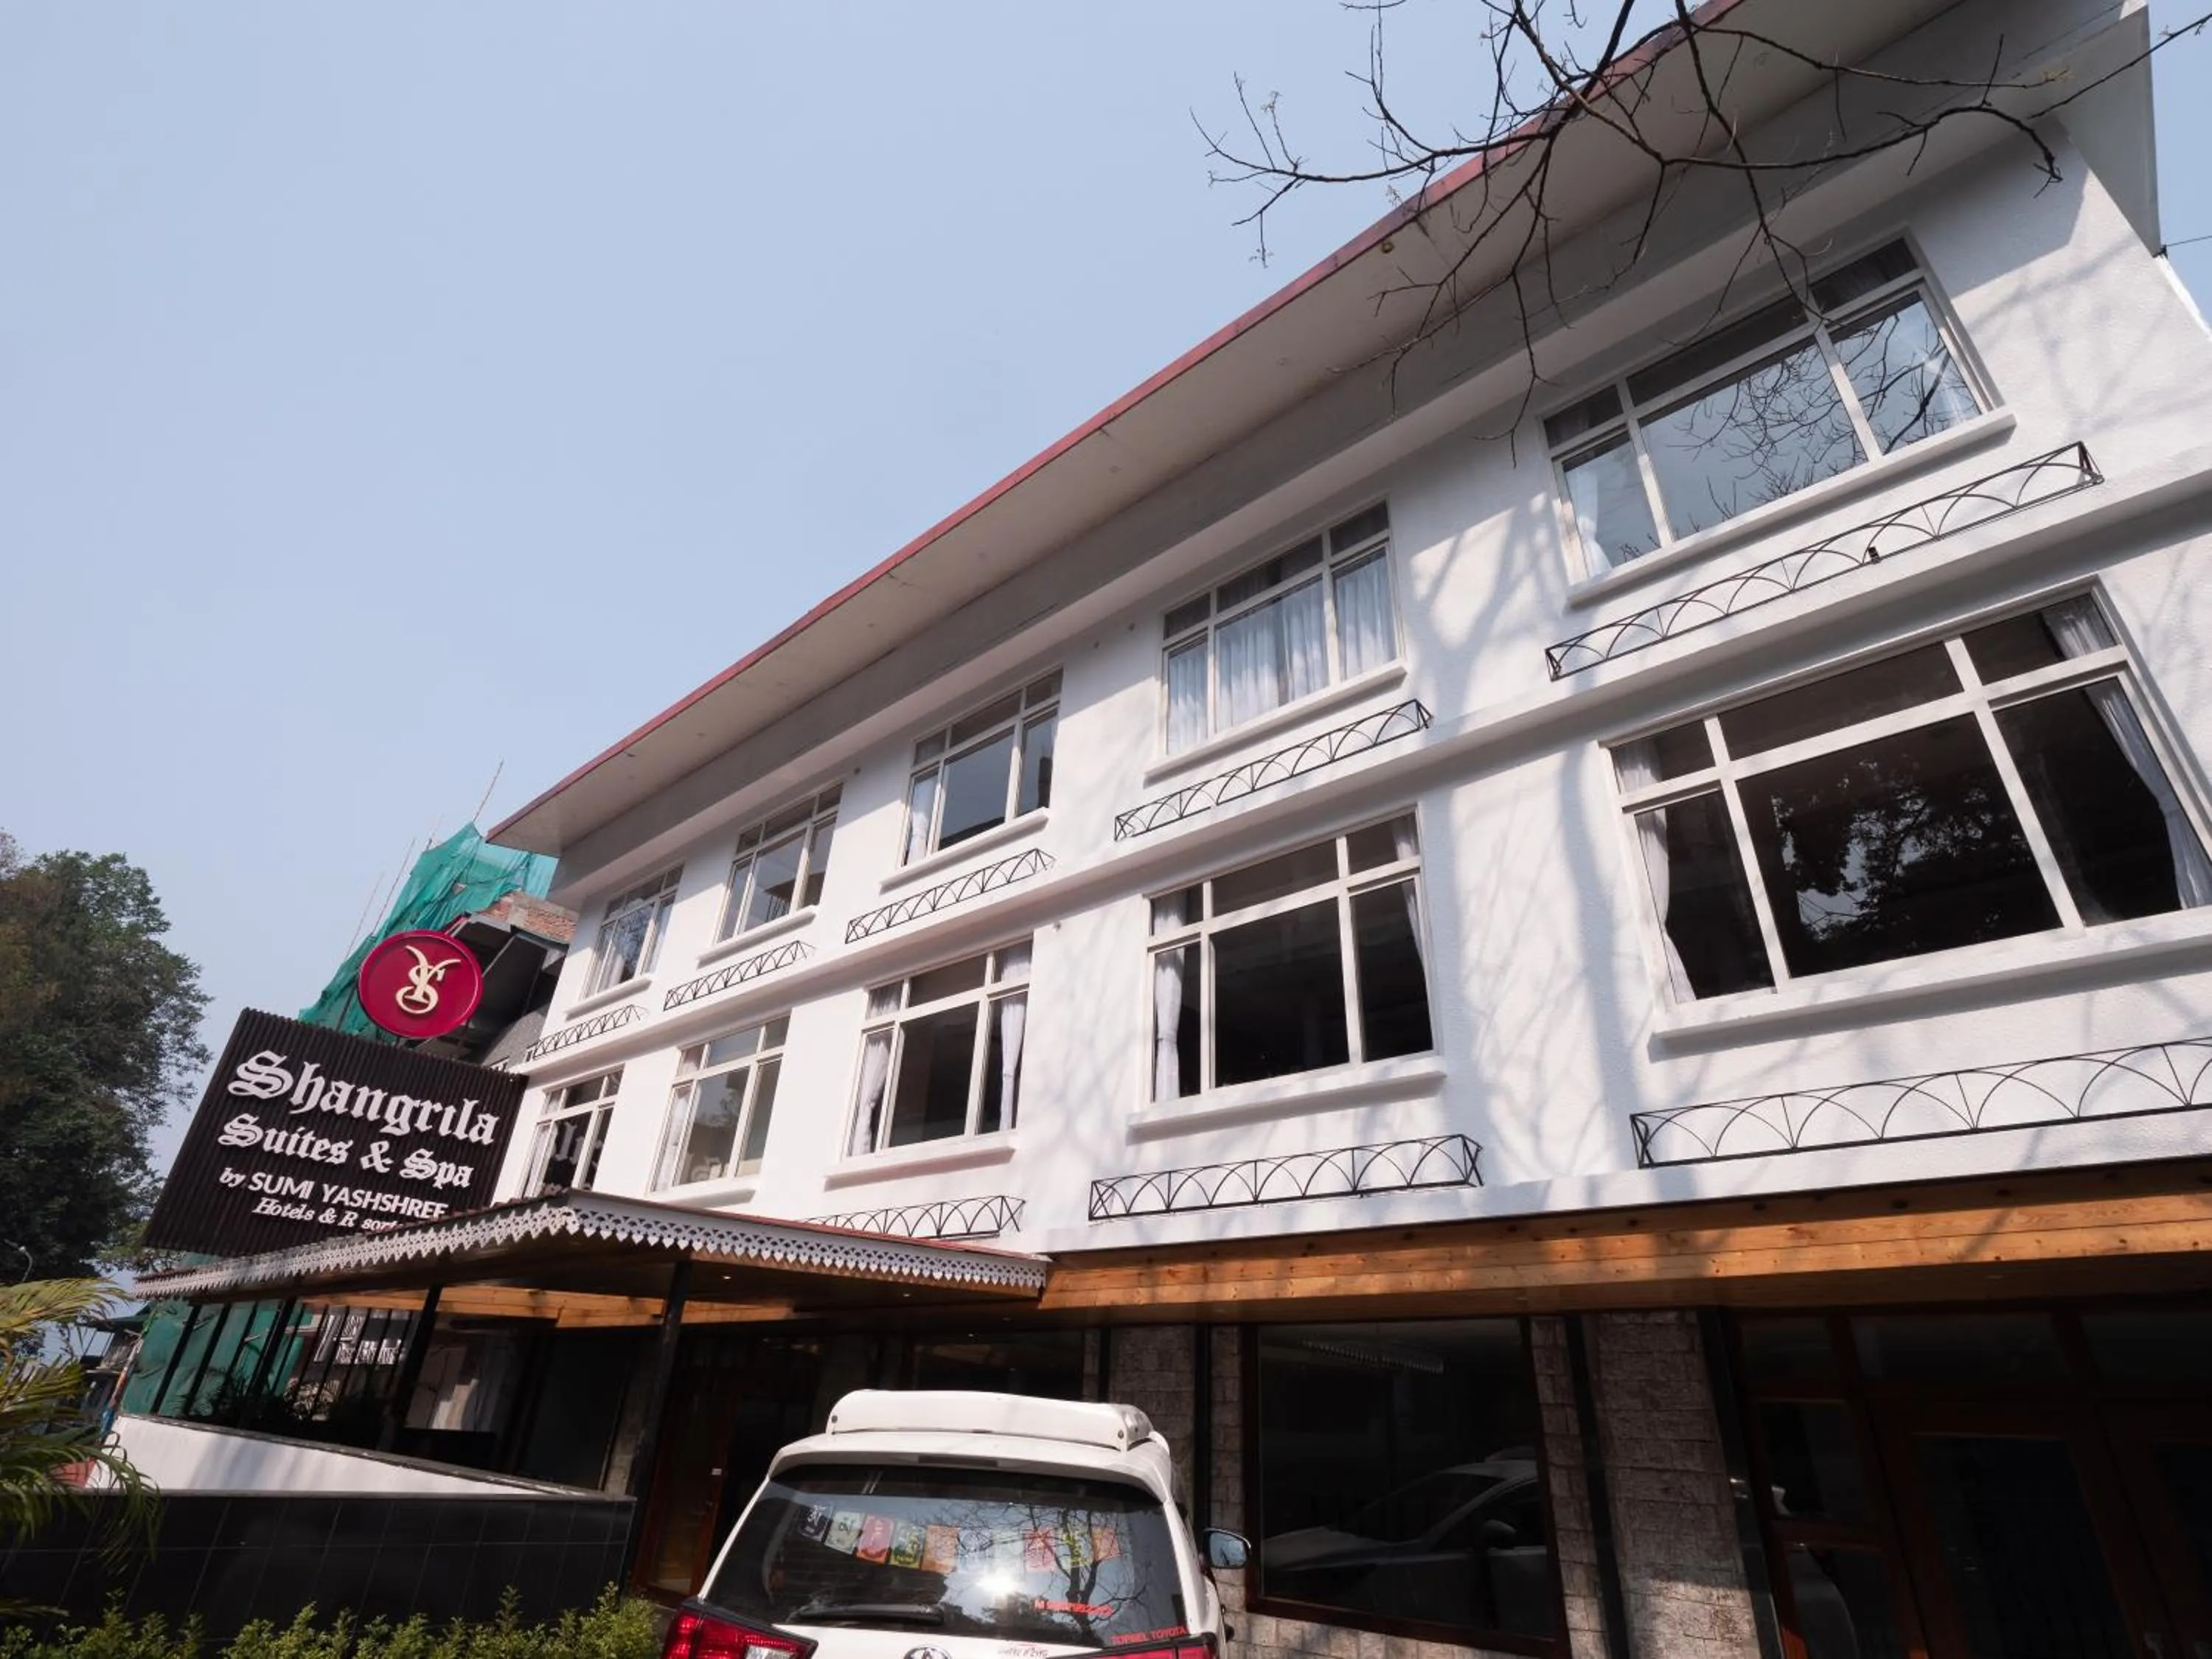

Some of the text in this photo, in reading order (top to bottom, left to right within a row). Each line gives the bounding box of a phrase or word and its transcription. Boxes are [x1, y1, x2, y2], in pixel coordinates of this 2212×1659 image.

[227, 1048, 501, 1146] Shangrila
[218, 1113, 474, 1189] Suites & Spa
[218, 1167, 246, 1188] by
[248, 1172, 315, 1200] SUMI
[251, 1197, 316, 1222] Hotels
[318, 1207, 337, 1225] &
[1152, 1625, 1188, 1641] TOYOTA
